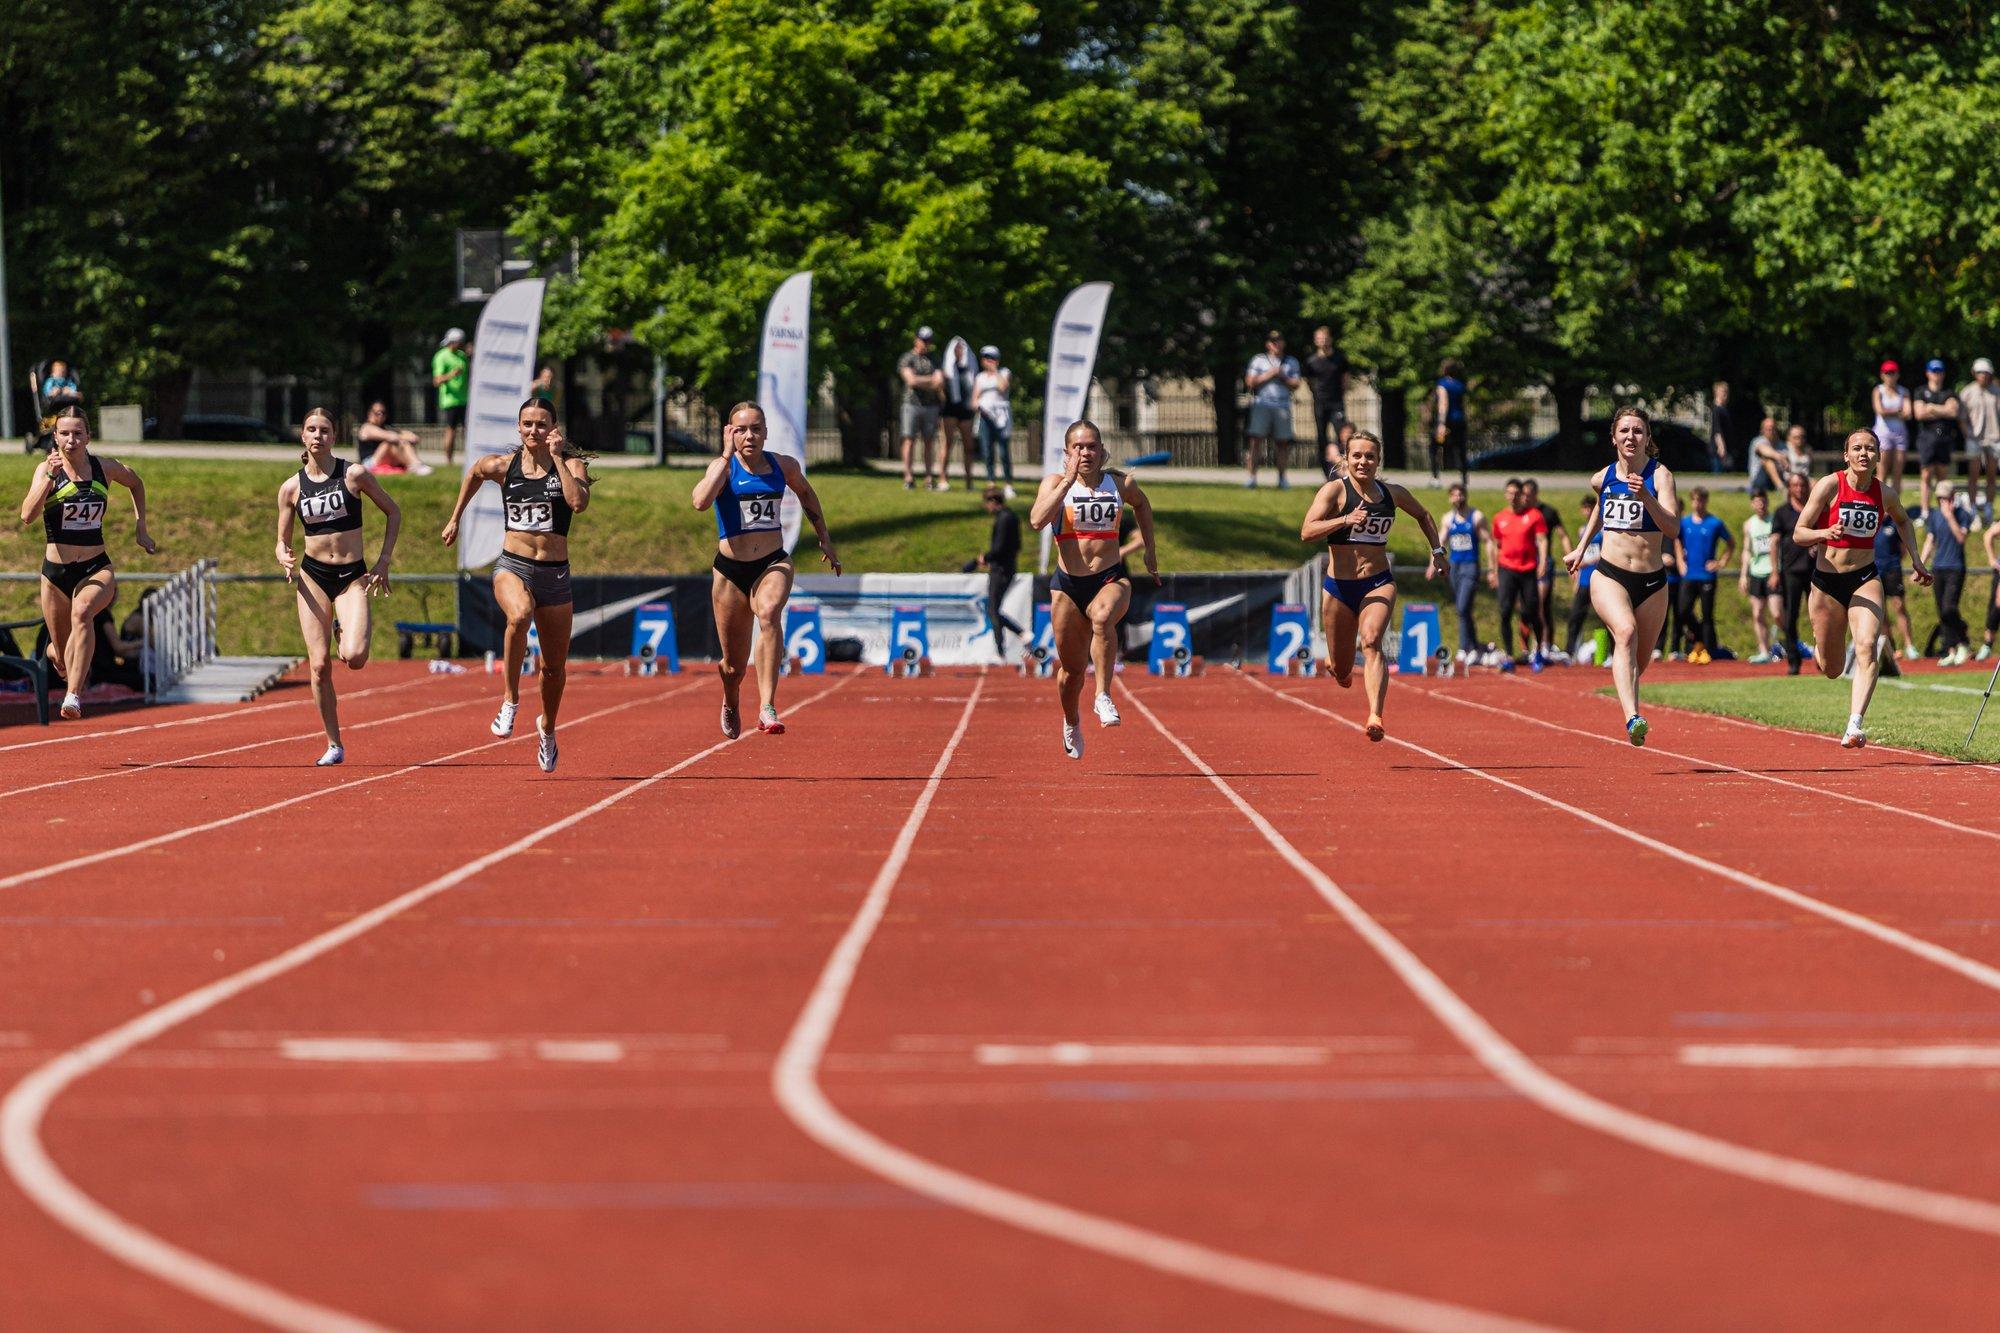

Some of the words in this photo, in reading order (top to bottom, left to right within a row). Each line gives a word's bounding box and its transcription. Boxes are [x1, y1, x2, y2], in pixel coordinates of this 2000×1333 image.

[65, 504, 102, 522] 247
[303, 493, 342, 517] 170
[509, 504, 550, 523] 313
[750, 501, 775, 521] 94
[1077, 503, 1116, 522] 104
[1605, 501, 1641, 520] 219
[1842, 511, 1877, 530] 188
[640, 620, 669, 654] 7
[789, 621, 819, 667] 6
[898, 621, 924, 660] 5
[1157, 622, 1187, 672] 3
[1275, 622, 1304, 668] 2
[1407, 621, 1429, 667] 1
